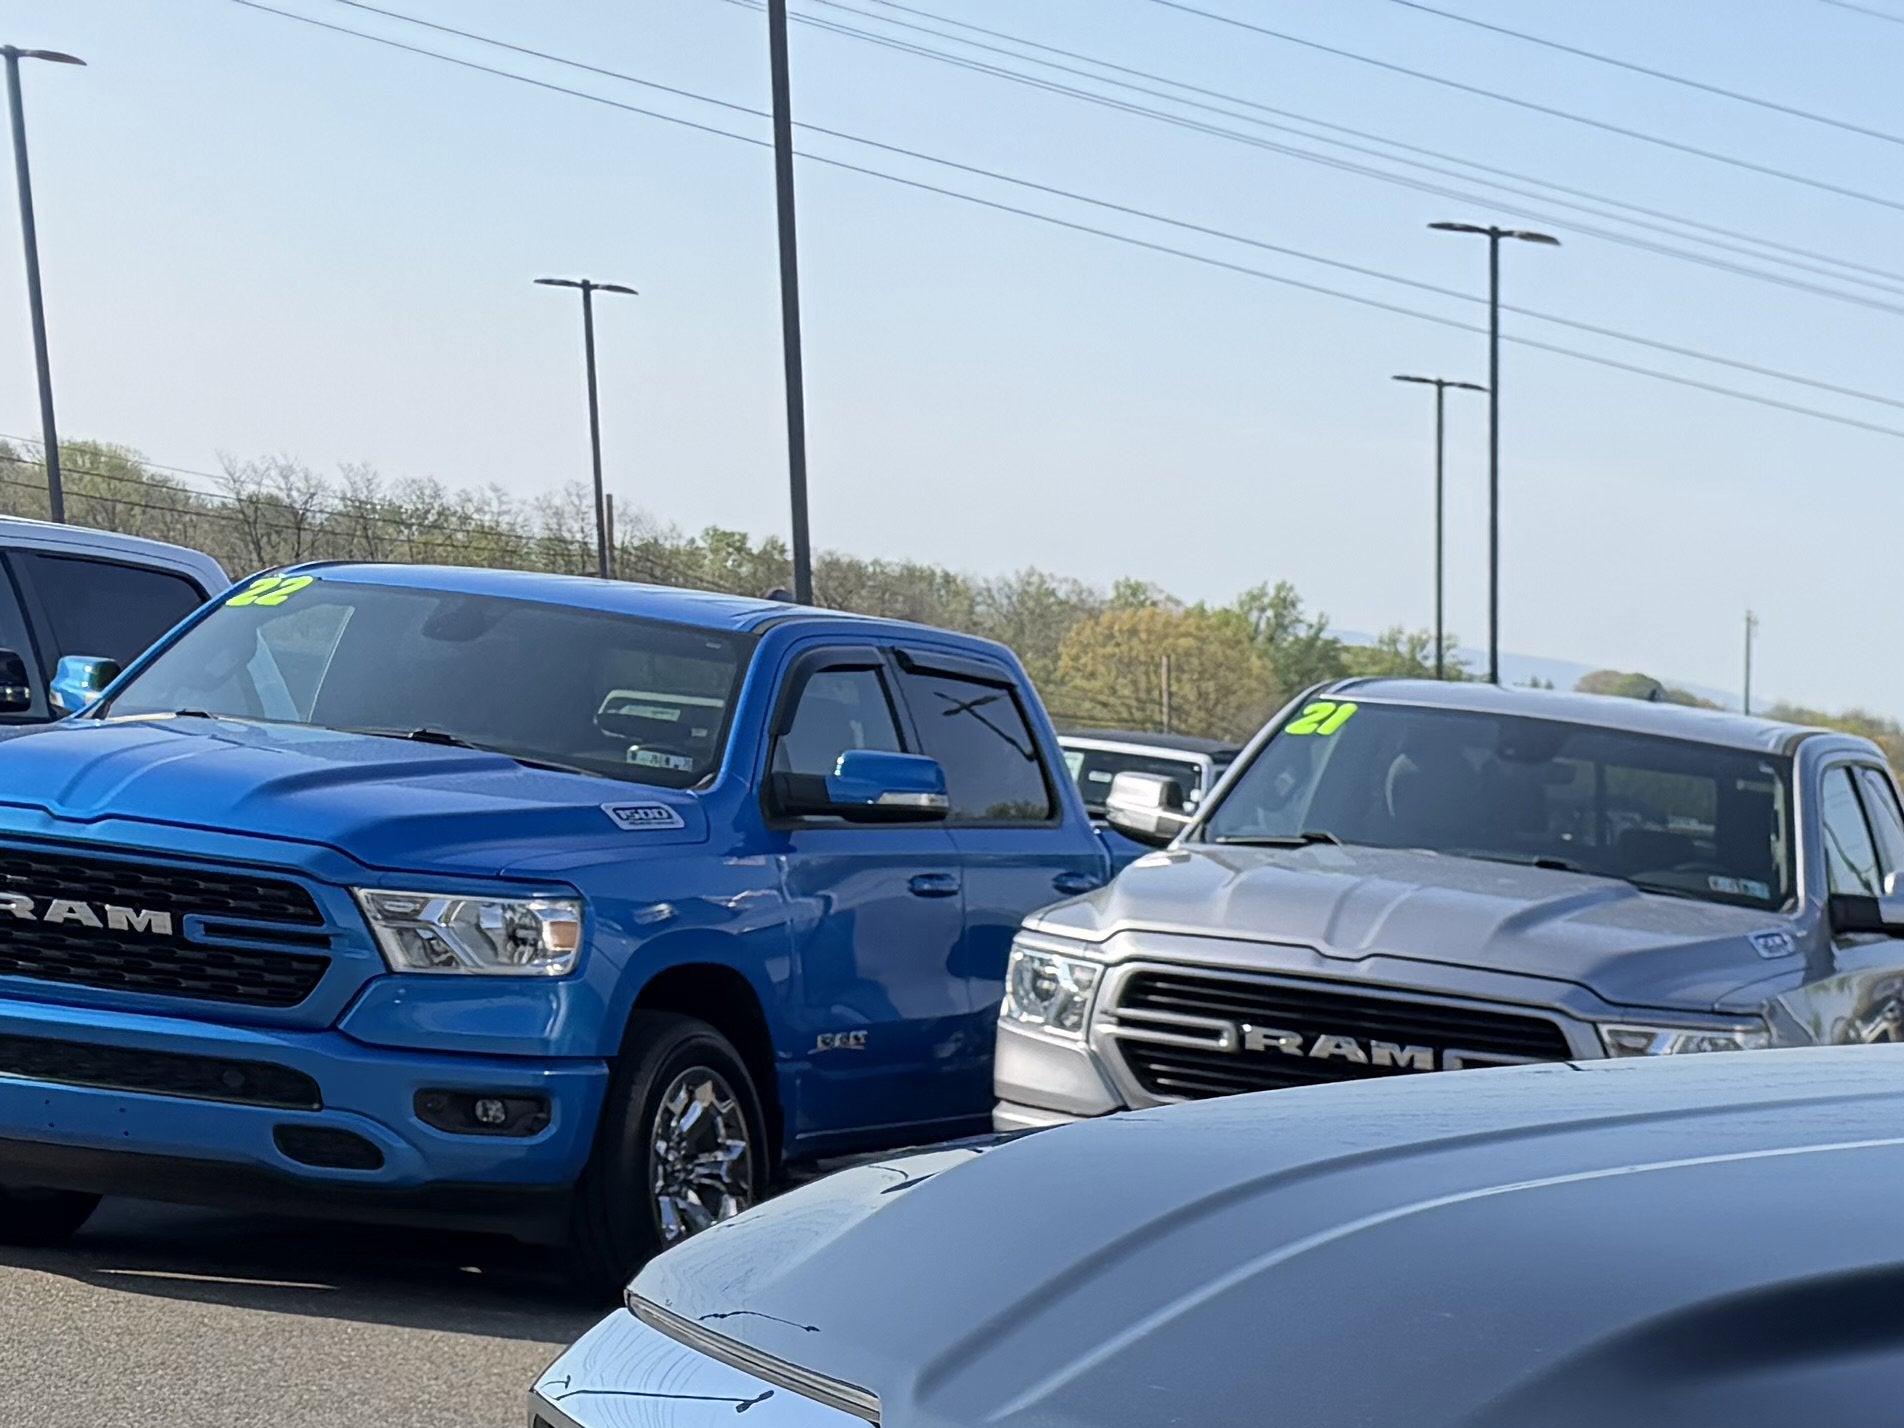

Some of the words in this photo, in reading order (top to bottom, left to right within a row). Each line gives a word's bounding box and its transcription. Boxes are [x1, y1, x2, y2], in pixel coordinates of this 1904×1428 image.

[225, 575, 313, 606] 22
[1284, 702, 1358, 735] 21
[1241, 1023, 1435, 1071] RAM
